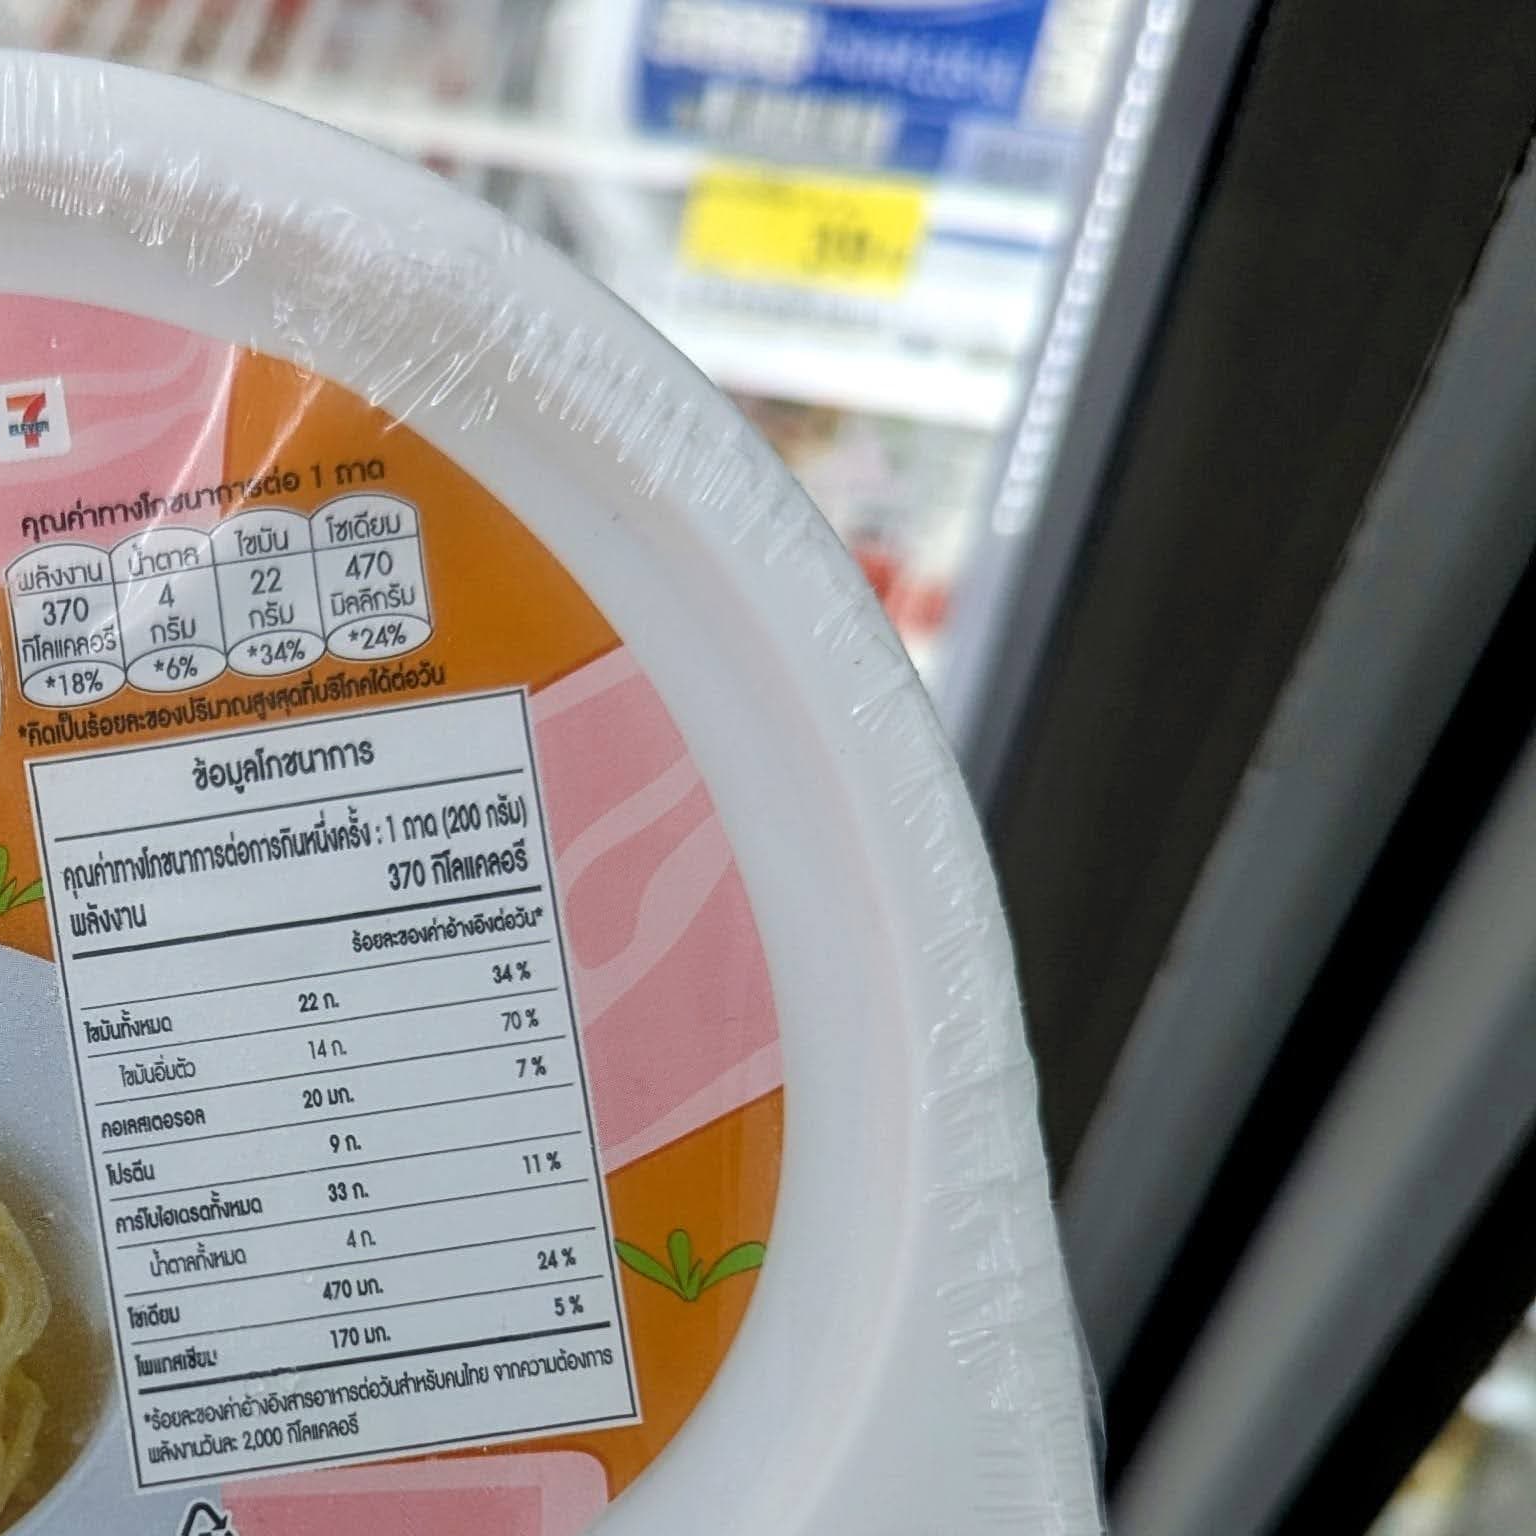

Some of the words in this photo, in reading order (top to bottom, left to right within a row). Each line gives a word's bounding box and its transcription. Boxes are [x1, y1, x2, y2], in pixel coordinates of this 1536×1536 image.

[311, 464, 322, 489] 1
[335, 459, 385, 485] ถาด
[234, 527, 293, 560] ไขมัน
[325, 511, 401, 543] โซเดียม
[250, 566, 282, 595] 22
[345, 550, 393, 580] 470
[42, 596, 89, 626] 370
[159, 583, 175, 608] 4
[248, 601, 294, 629] กรัม
[331, 583, 415, 616] มิลลิกรัม
[150, 616, 196, 644] กรัม
[192, 740, 375, 794] ข้อมูลโภชนาการ
[403, 813, 438, 840] ถาด
[442, 803, 481, 839] (200
[485, 795, 527, 828] กรัม)
[70, 904, 147, 937] พลังงาน
[388, 859, 426, 891] 370
[431, 838, 528, 884] กิโลแคลอรี
[83, 1010, 172, 1043] ไขมันทั้งหมด
[298, 992, 319, 1012] 22
[492, 964, 513, 984] 34
[516, 961, 531, 981] %
[118, 1055, 196, 1086] ไขมันอิ่มตัว
[308, 1039, 327, 1059] 14
[501, 1011, 522, 1032] 70
[525, 1008, 539, 1028] %
[101, 1108, 206, 1138] คอเลสเตอรอล
[302, 1088, 323, 1109] 20
[516, 1058, 527, 1077] 7
[531, 1056, 547, 1076] %
[106, 1159, 155, 1185] โปรตีน
[329, 1134, 340, 1153] 9
[328, 1182, 347, 1202] 33
[522, 1154, 541, 1174] 11
[546, 1151, 561, 1171] %
[150, 1242, 247, 1277] น้ำตาลทั้งหมด
[347, 1229, 356, 1248] 4
[323, 1279, 352, 1300] 470
[537, 1250, 558, 1270] 24
[561, 1247, 577, 1266] %
[330, 1327, 359, 1349] 170
[554, 1297, 565, 1316] 5
[569, 1295, 584, 1315] %
[493, 1348, 614, 1381] จากความต้องการ
[242, 1426, 283, 1451] 2,000
[286, 1412, 359, 1444] กิโลแคลอรี
